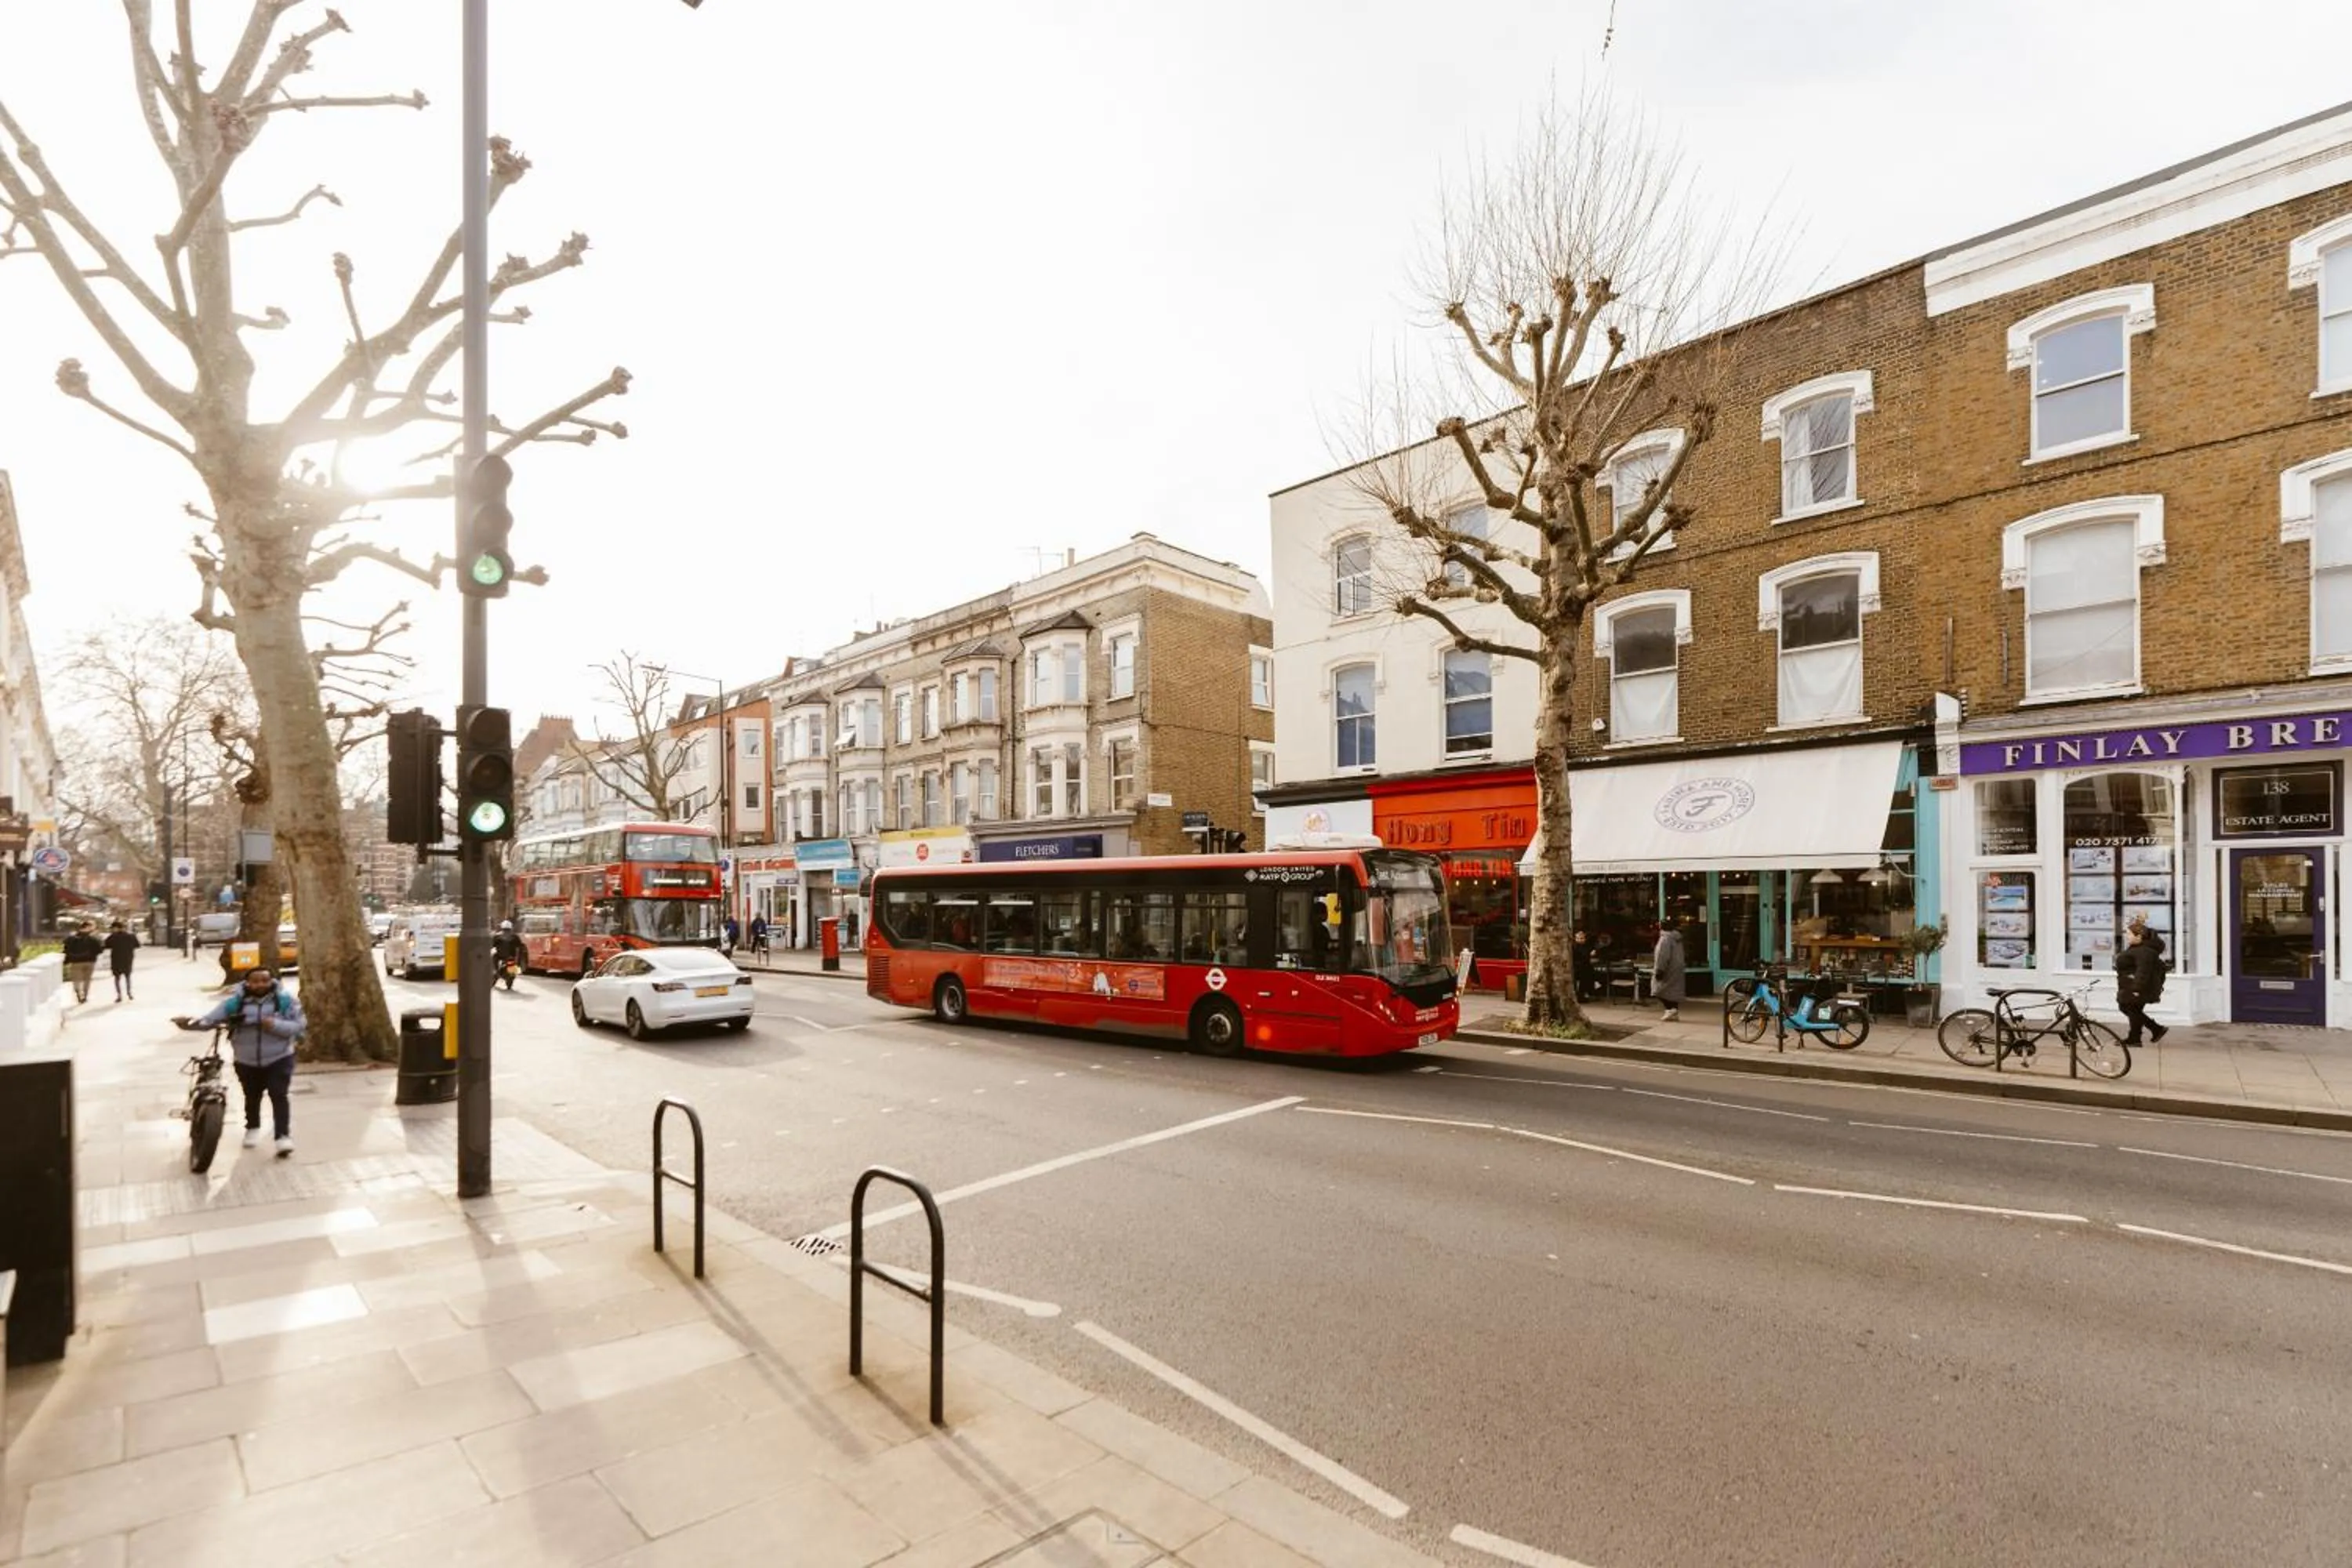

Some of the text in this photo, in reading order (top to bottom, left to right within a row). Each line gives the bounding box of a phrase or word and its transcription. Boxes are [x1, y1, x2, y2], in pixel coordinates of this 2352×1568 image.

[2003, 717, 2341, 767] FINLAY BRE
[2262, 780, 2291, 795] 138
[2225, 813, 2330, 826] ESTATE AGENT
[1386, 812, 1526, 846] Hong Tin
[2075, 837, 2100, 847] 020
[1015, 844, 1060, 857] FLETCHERS
[1487, 858, 1513, 877] TIN
